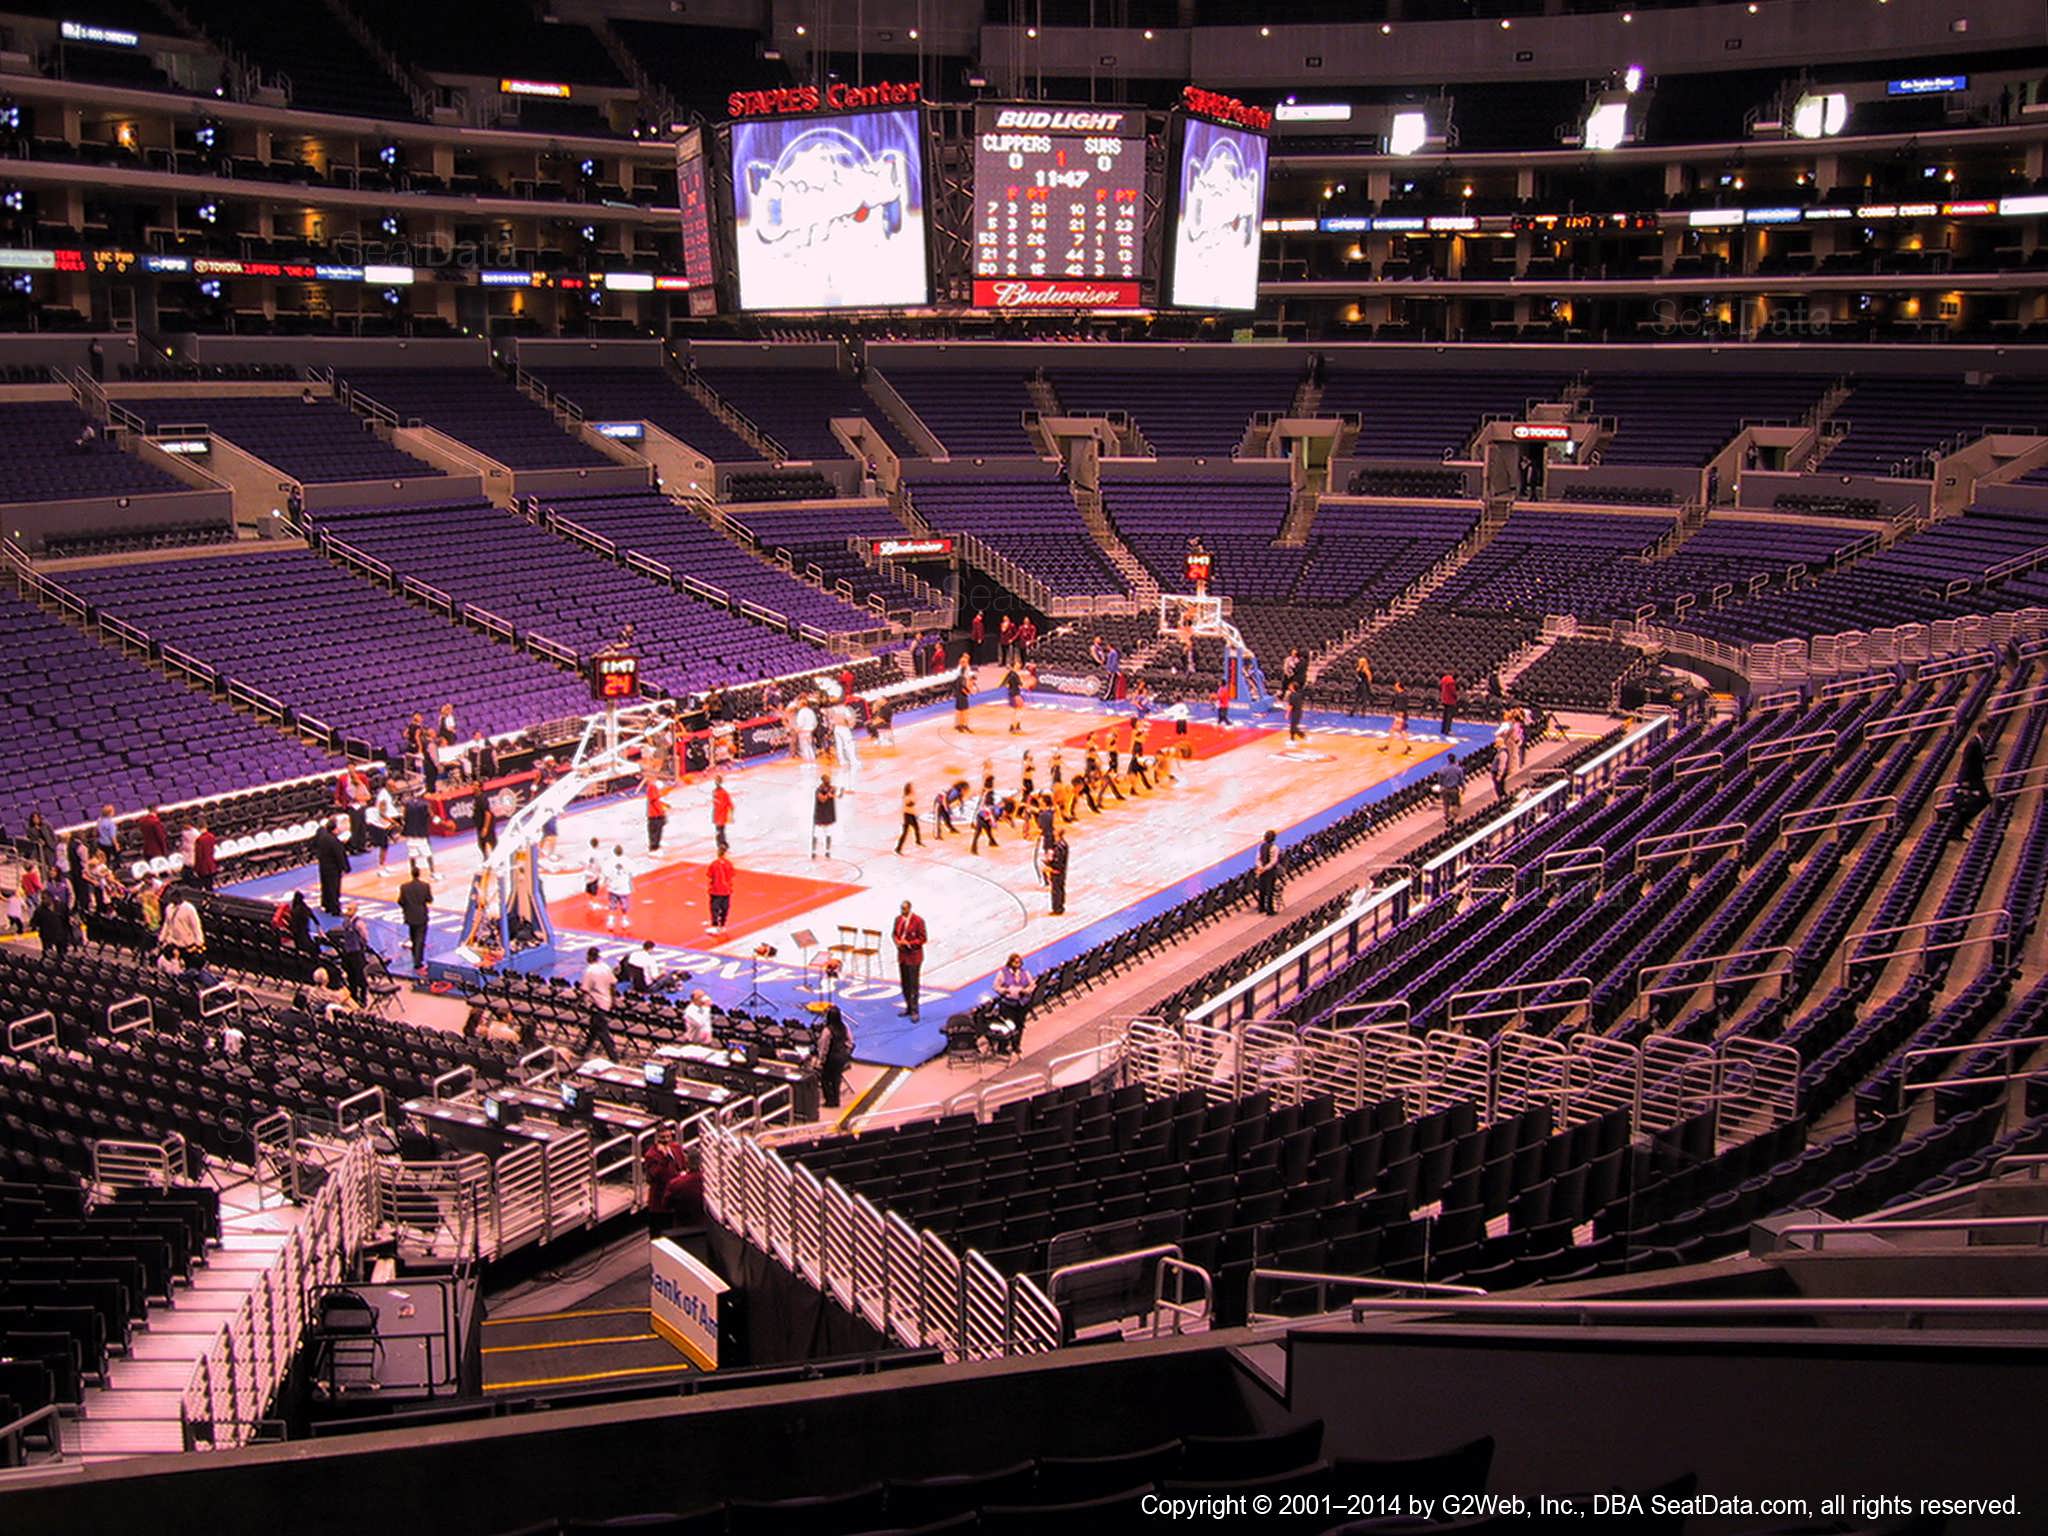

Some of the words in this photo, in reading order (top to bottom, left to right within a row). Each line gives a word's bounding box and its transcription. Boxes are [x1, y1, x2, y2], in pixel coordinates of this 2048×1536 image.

[728, 85, 819, 117] STAPLES
[826, 81, 921, 109] Center
[997, 110, 1051, 129] BUD
[1051, 111, 1123, 130] LIGHT
[982, 134, 1051, 153] CLIPPERS
[1084, 137, 1122, 155] SUNS
[1008, 153, 1023, 170] 0
[1056, 150, 1067, 167] 1
[1097, 156, 1112, 172] 0
[1035, 170, 1089, 188] 11:47
[208, 260, 243, 273] TOYOTA
[993, 282, 1120, 306] Budweiser
[1529, 427, 1569, 438] TOYOTA
[880, 541, 944, 556] Budweiser
[604, 674, 631, 696] 24
[683, 1293, 698, 1321] of
